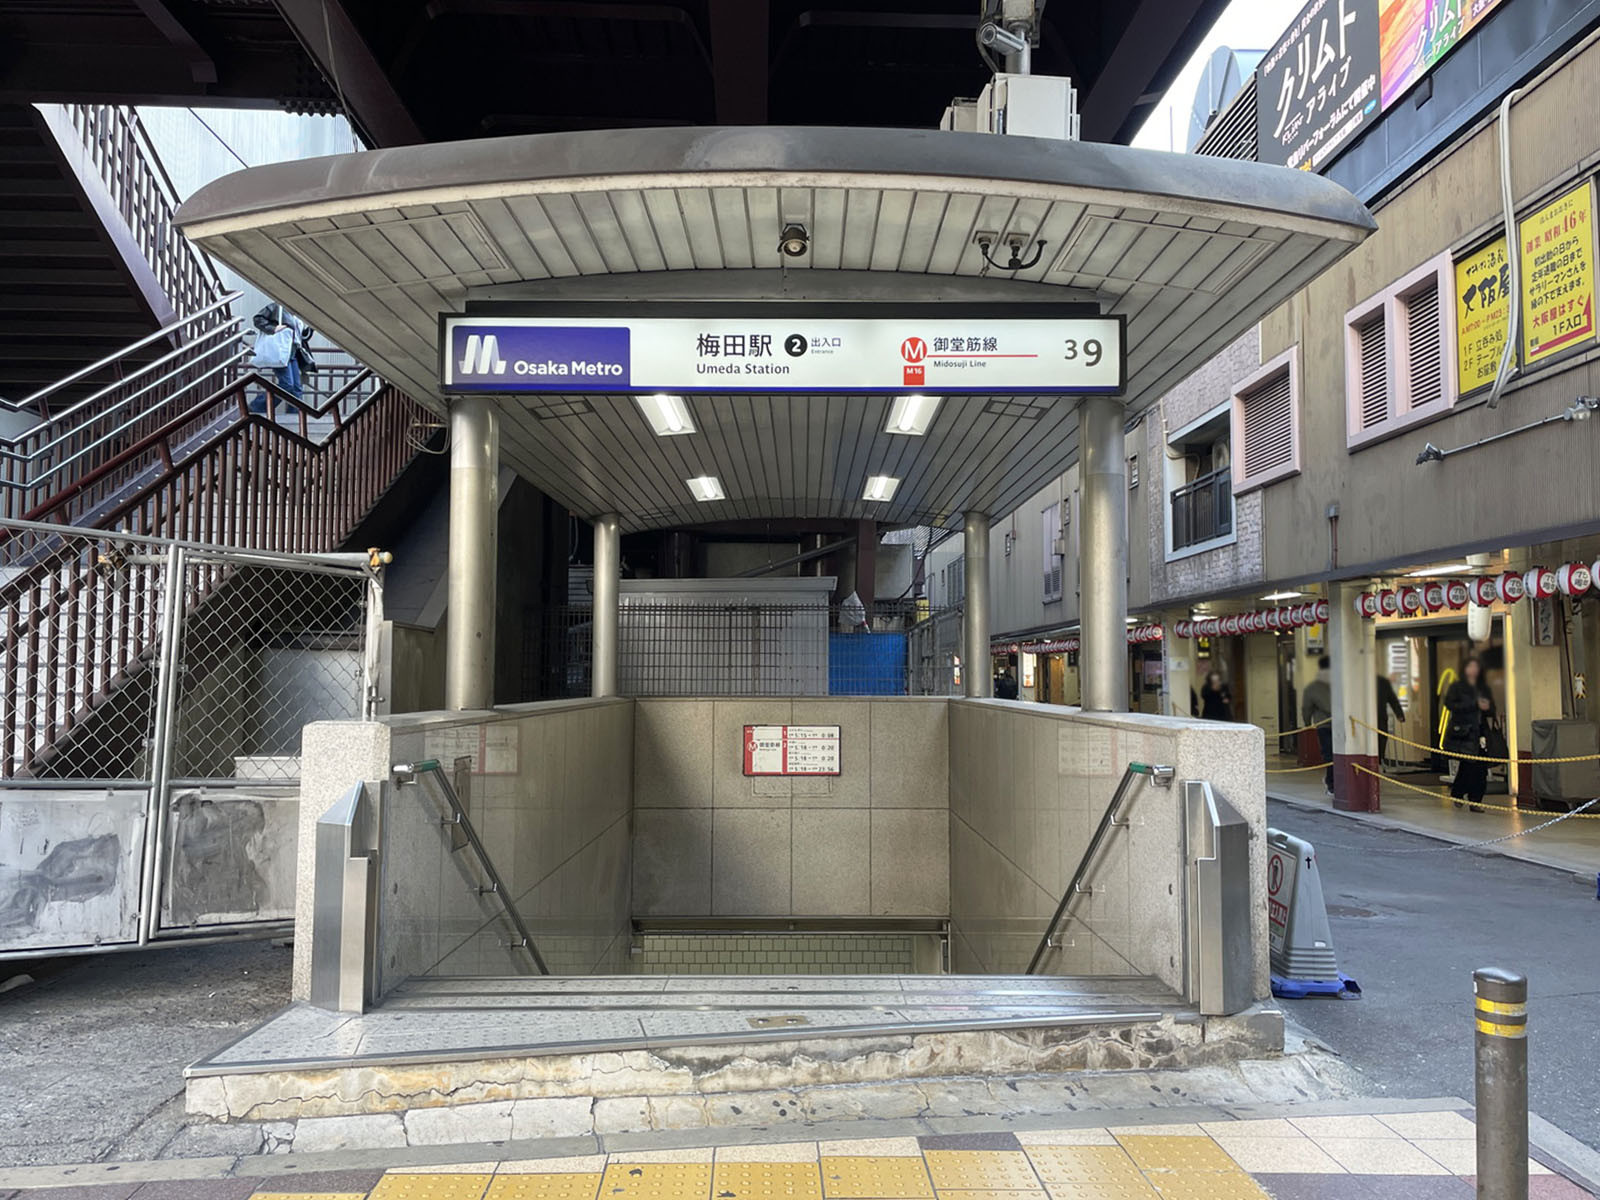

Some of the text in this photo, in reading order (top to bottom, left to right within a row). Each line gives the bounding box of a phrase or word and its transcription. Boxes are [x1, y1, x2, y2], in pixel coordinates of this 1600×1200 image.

[1273, 0, 1357, 138] クリムト
[1306, 56, 1352, 124] アライブ
[1529, 261, 1586, 297] サラリーマンさんを
[696, 333, 772, 357] 梅田駅
[811, 338, 842, 348] 出入口
[933, 337, 998, 352] 御堂筋線
[1064, 338, 1103, 367] 39
[1464, 342, 1507, 371] 2F テーブル
[513, 359, 623, 376] Osaka Metro
[696, 363, 790, 375] Umeda Station
[906, 367, 923, 376] M16
[934, 360, 986, 369] Midosuji Line
